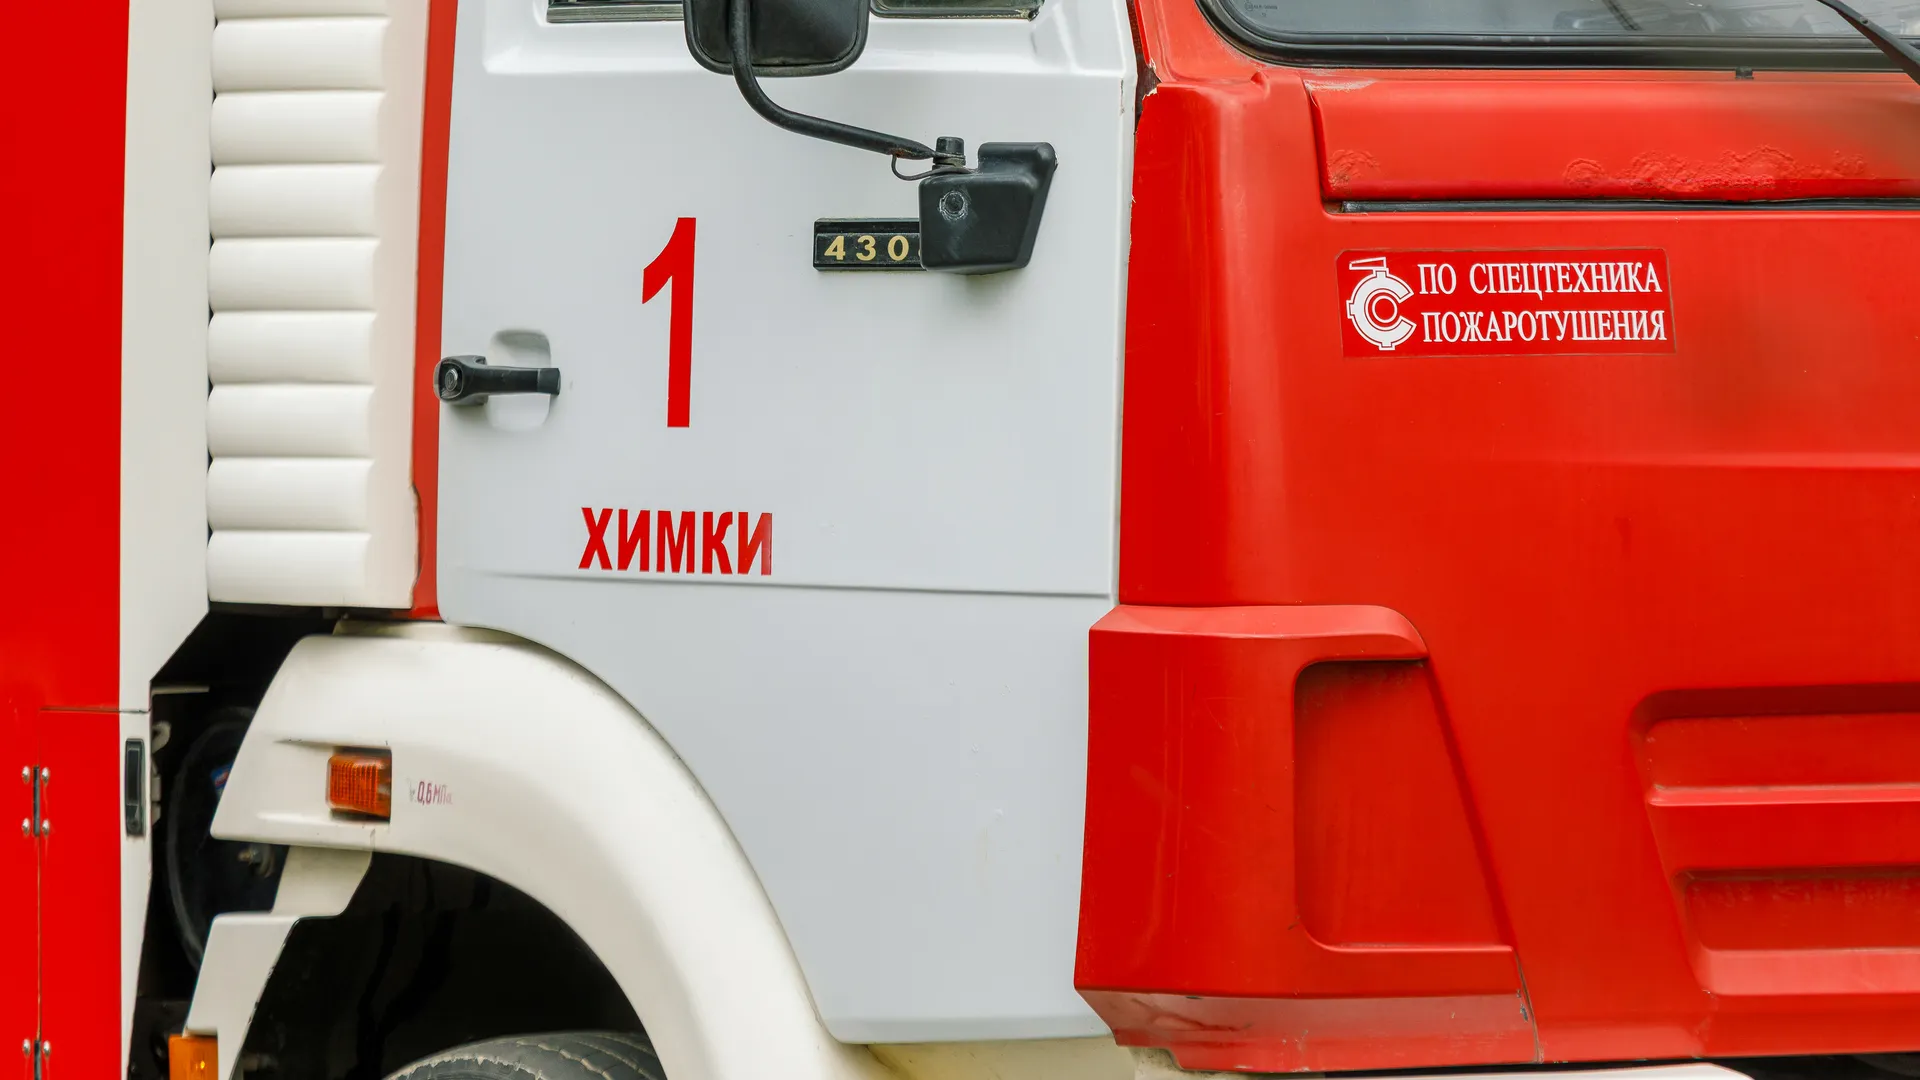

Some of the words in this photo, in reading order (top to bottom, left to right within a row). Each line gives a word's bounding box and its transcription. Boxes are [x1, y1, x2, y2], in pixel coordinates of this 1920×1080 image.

[824, 235, 921, 261] 430
[1417, 264, 1457, 295] ПО
[1469, 262, 1663, 301] СПЕЦТЕХНИКА
[641, 217, 696, 428] 1
[1421, 311, 1668, 342] ПОЖАРОТУШЕНИЯ
[578, 506, 773, 576] ХИМКИ
